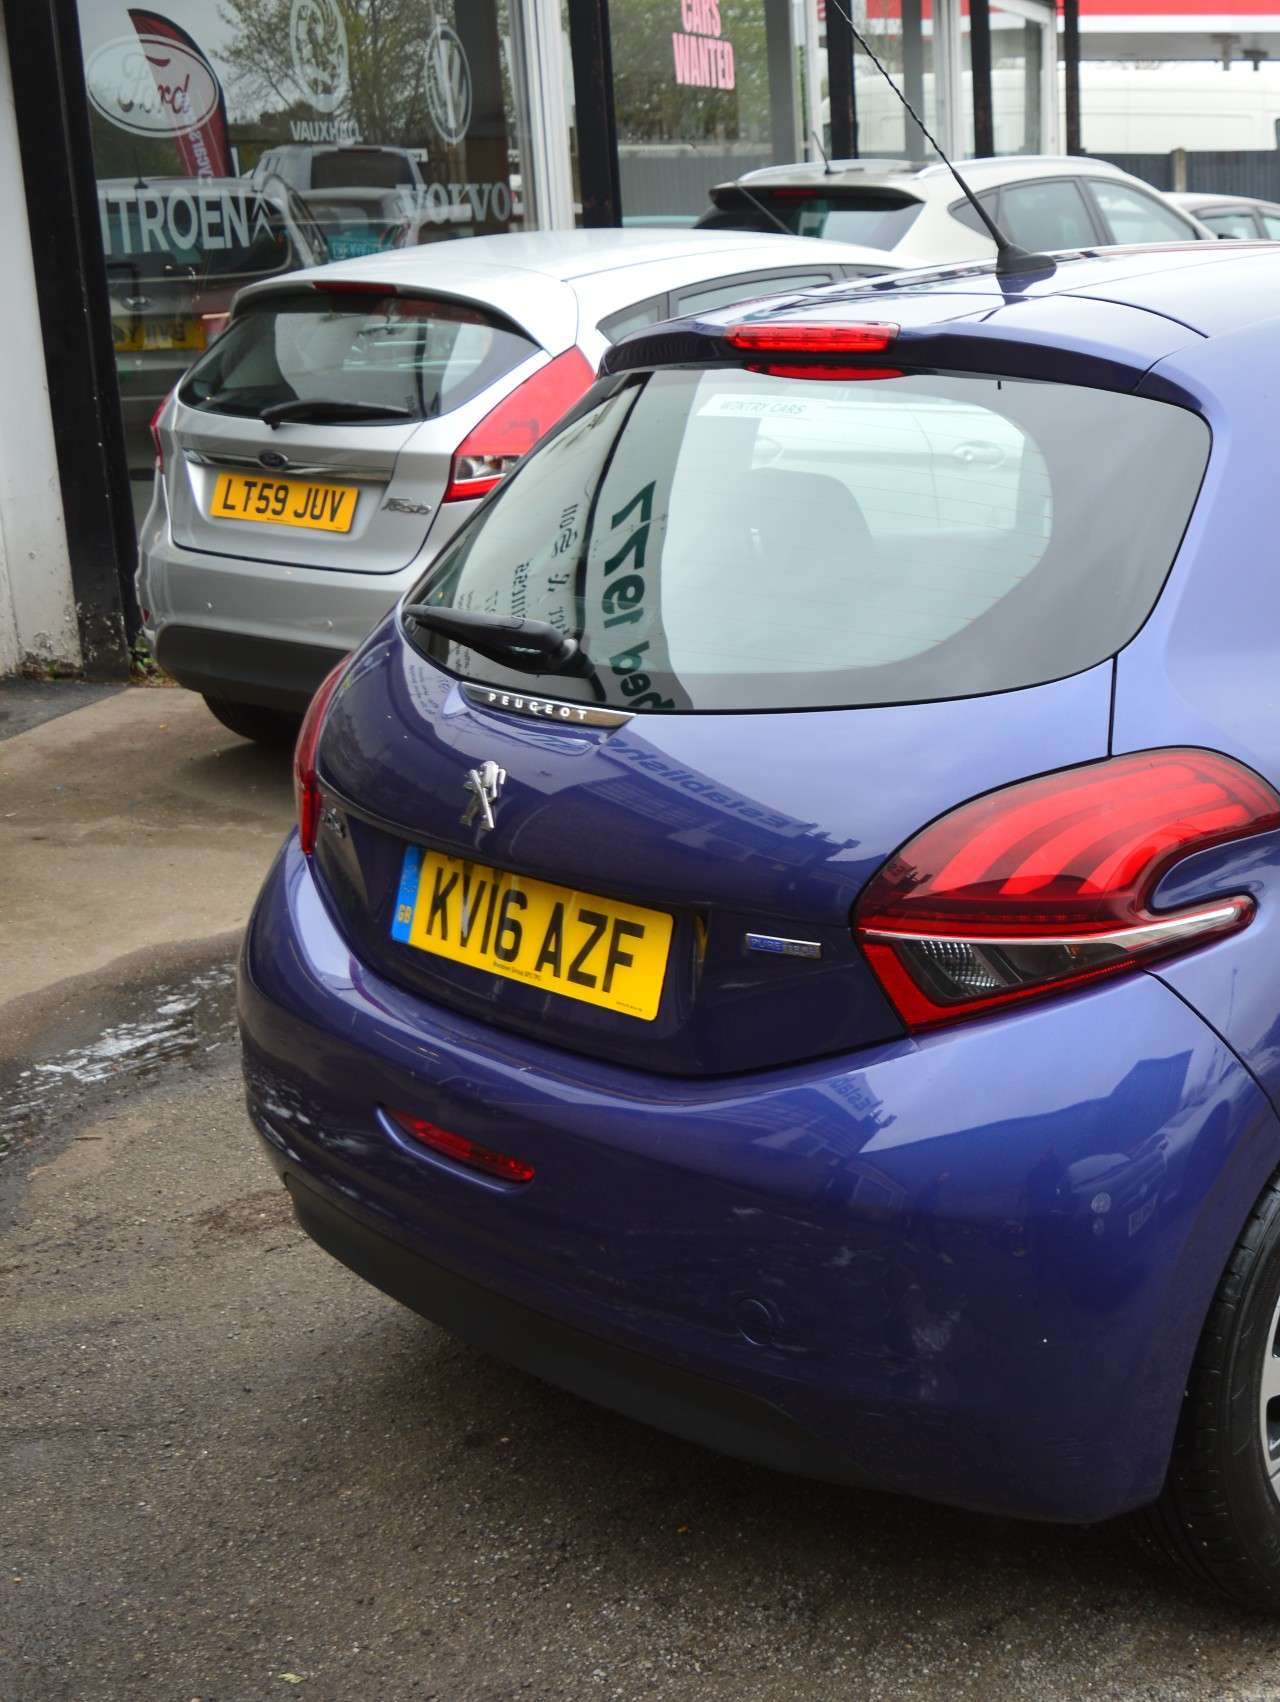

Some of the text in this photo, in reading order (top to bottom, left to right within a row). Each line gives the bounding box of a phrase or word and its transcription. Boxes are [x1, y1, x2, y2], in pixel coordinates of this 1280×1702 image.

[117, 52, 191, 114] Ford
[672, 32, 736, 91] WANTED
[290, 120, 364, 143] VAUXHALL
[96, 186, 250, 256] ITROEN
[395, 181, 513, 225] VOLVO
[222, 479, 346, 522] LT59 JUV
[488, 692, 588, 721] PEUGEOT
[398, 903, 413, 924] GB
[425, 866, 646, 995] KV16 AZF
